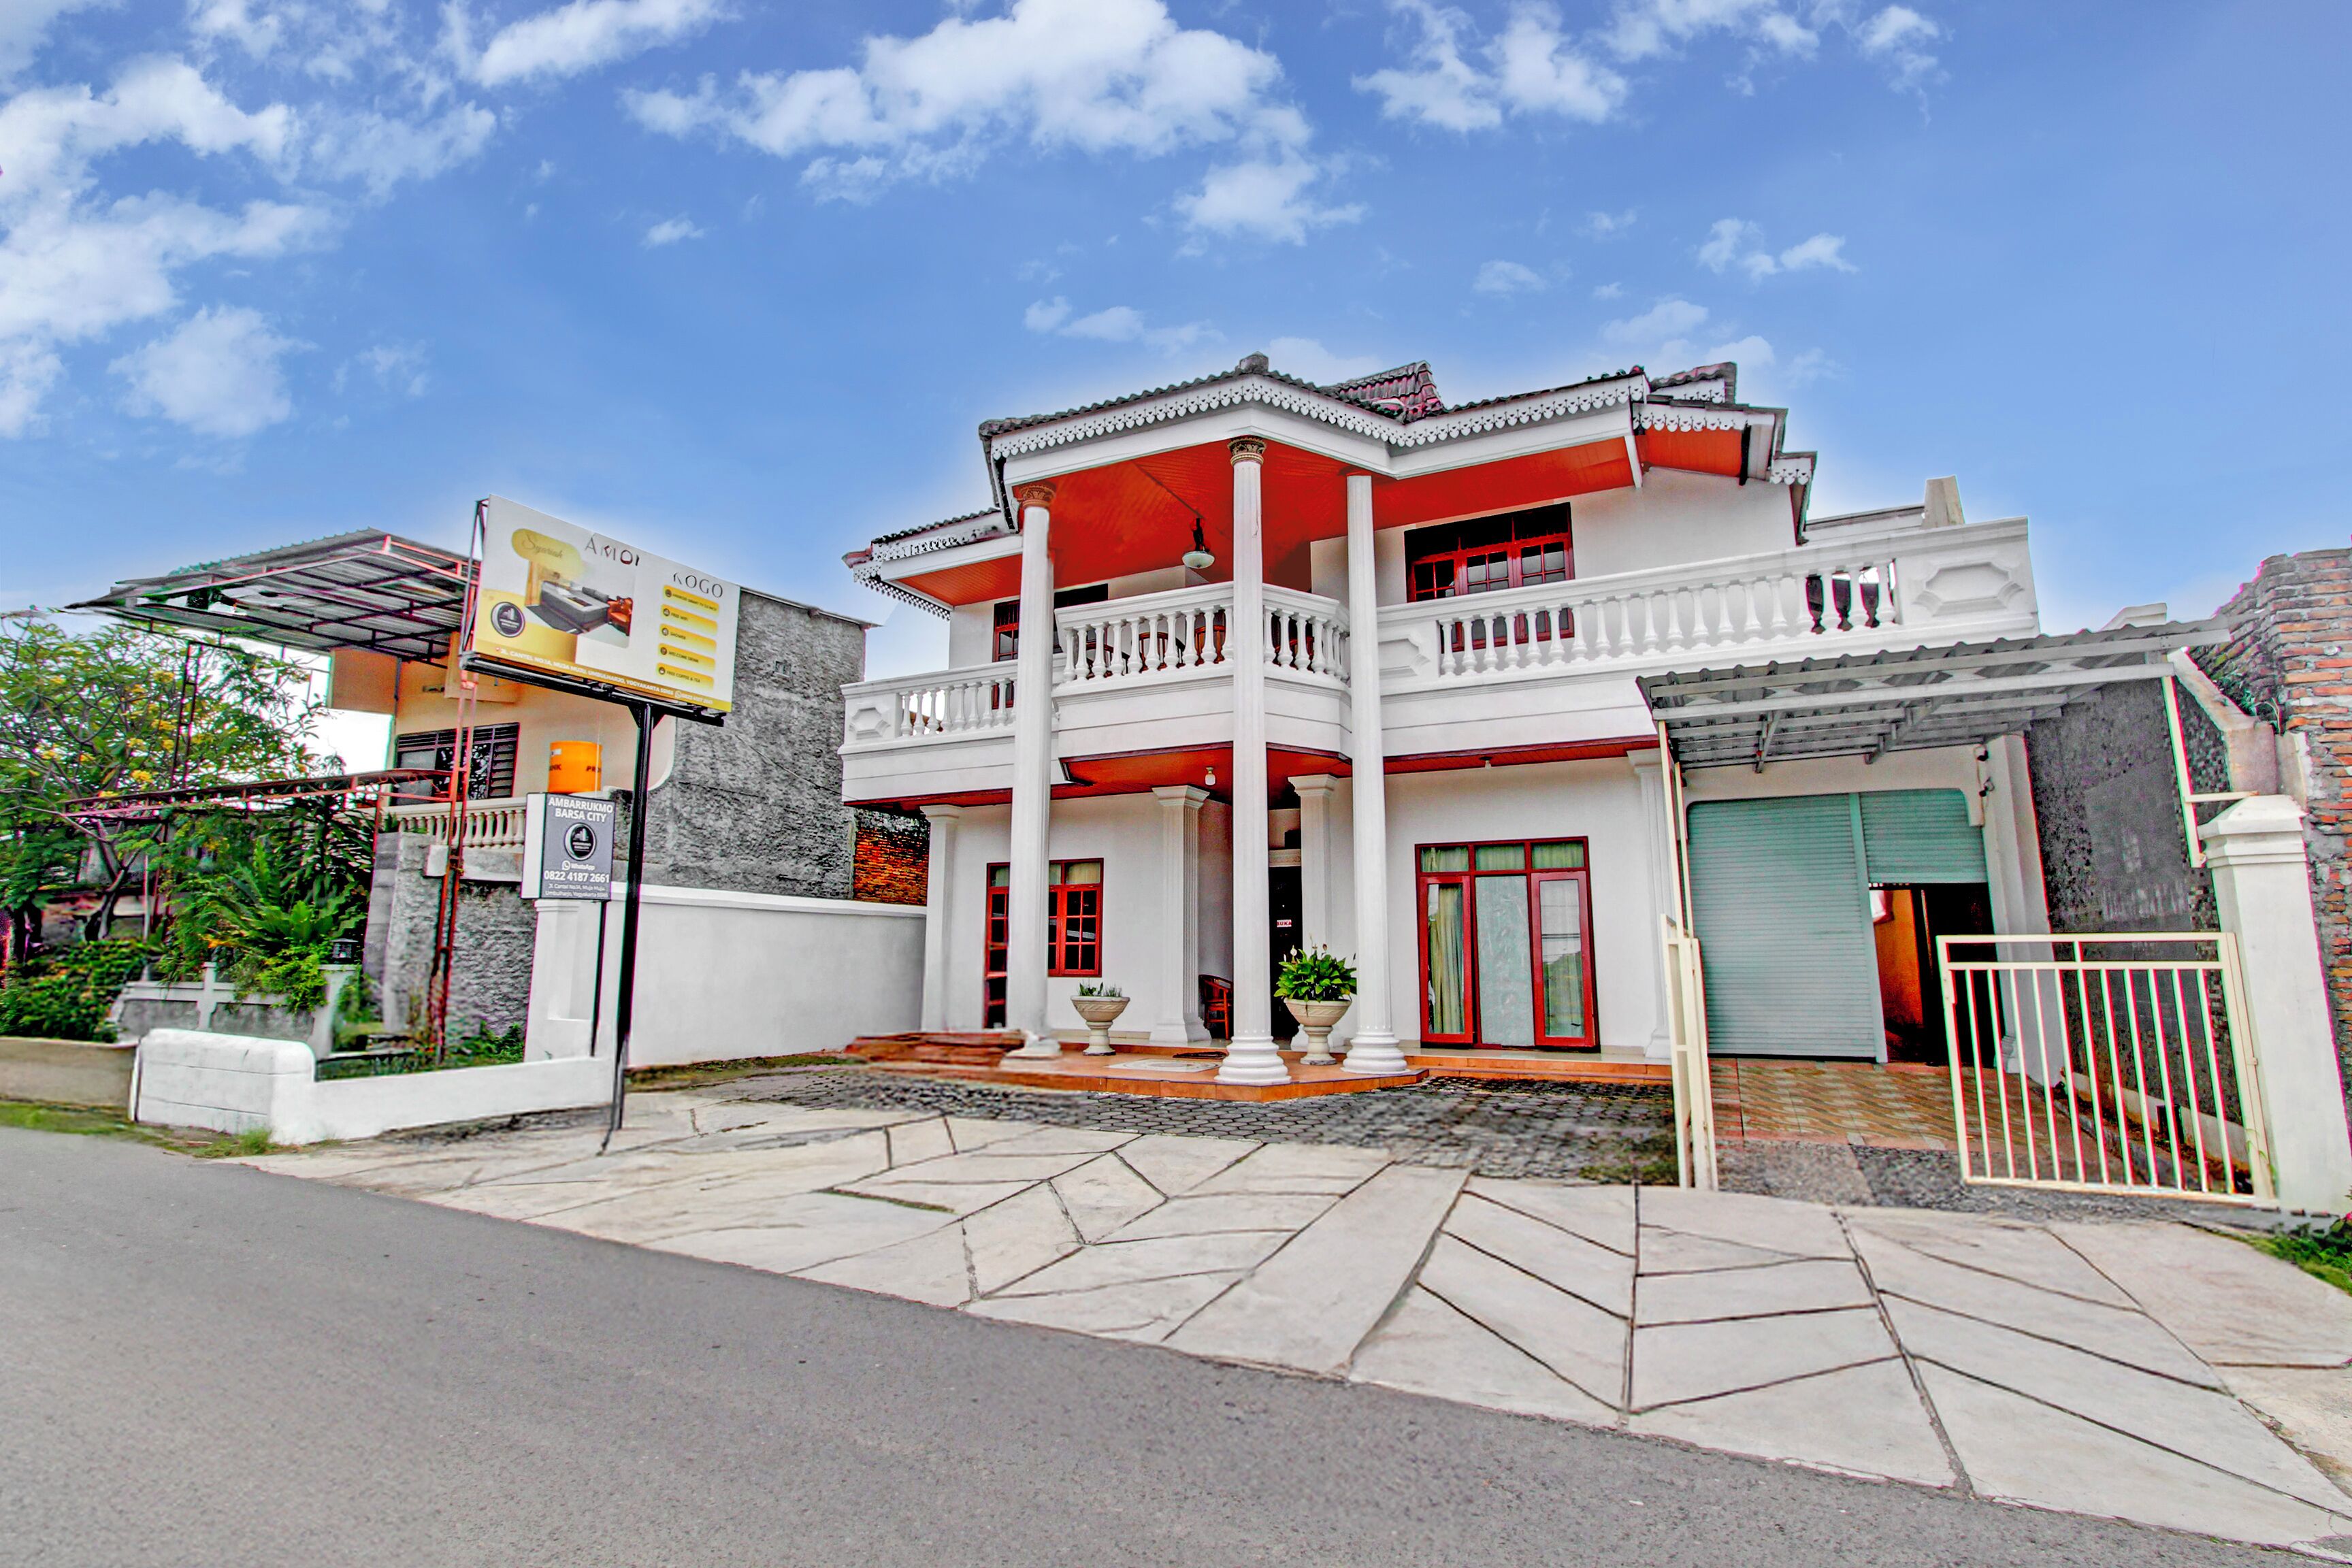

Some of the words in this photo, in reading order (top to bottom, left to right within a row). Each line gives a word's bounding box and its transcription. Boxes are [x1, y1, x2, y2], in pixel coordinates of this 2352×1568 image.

[548, 796, 613, 813] AMBARRUKMO
[555, 808, 586, 820] BARSA
[587, 812, 607, 823] CITY
[544, 870, 566, 881] 0822
[567, 872, 589, 881] 4187
[589, 873, 610, 883] 2661
